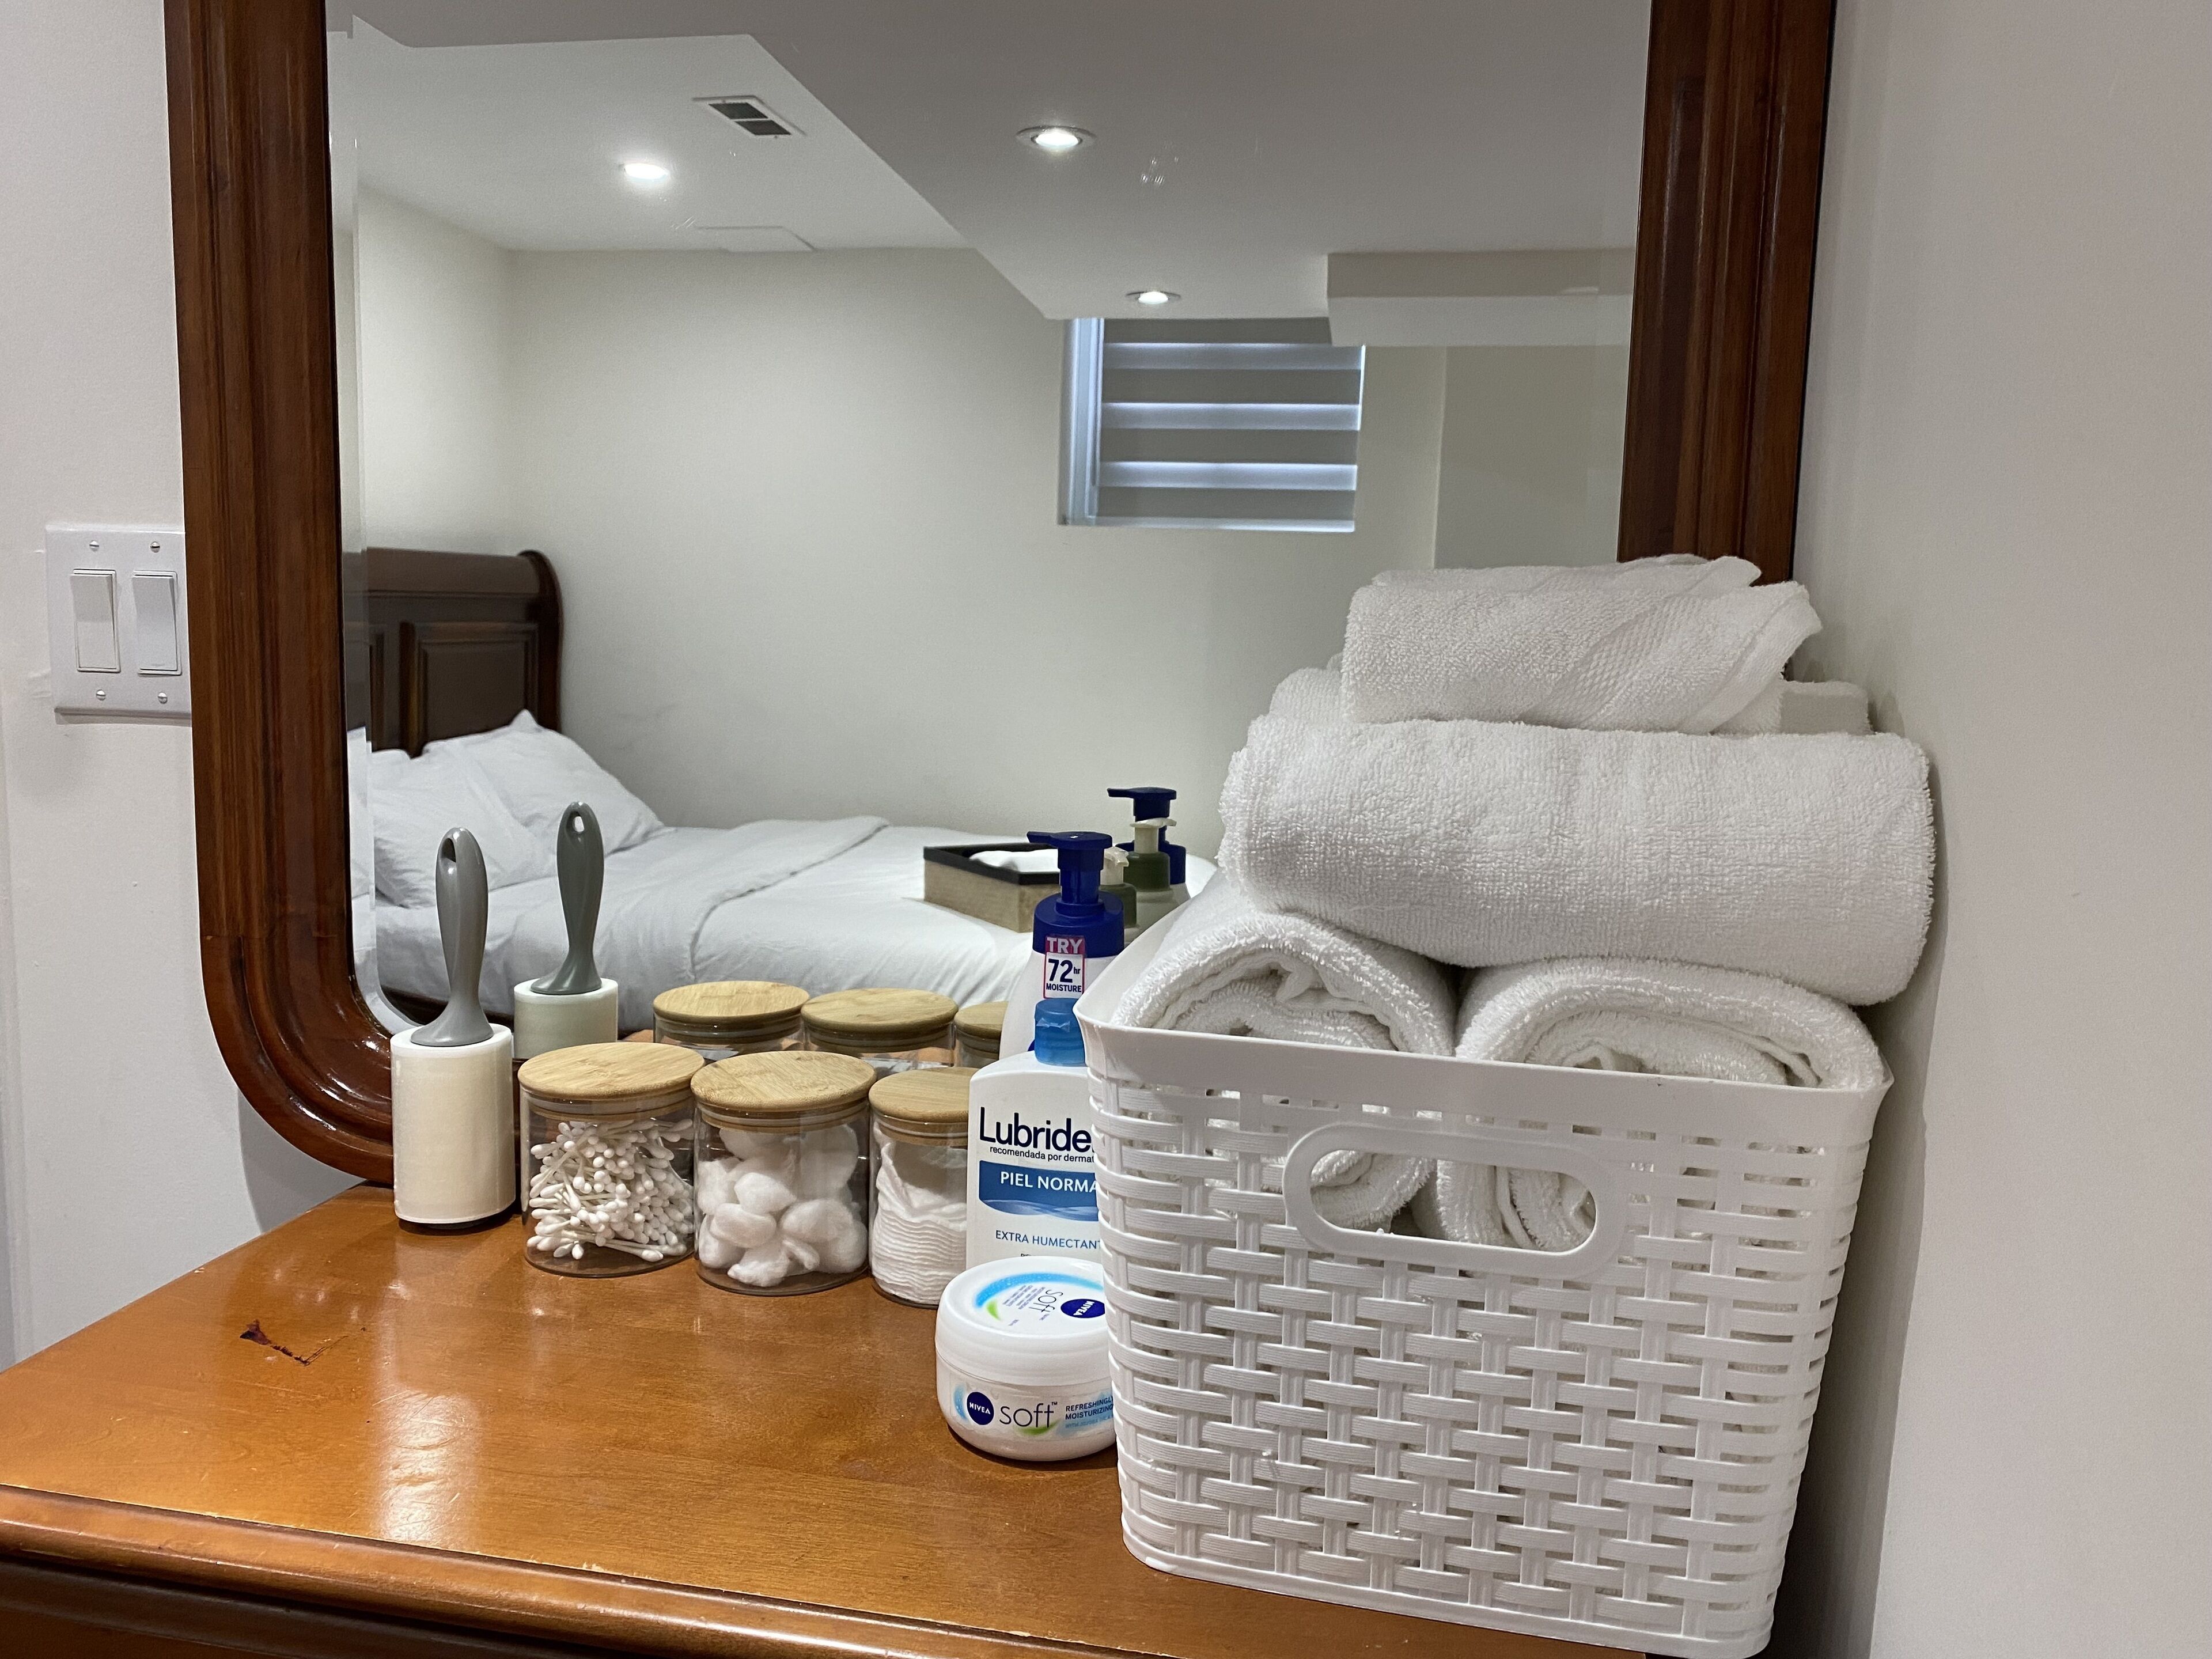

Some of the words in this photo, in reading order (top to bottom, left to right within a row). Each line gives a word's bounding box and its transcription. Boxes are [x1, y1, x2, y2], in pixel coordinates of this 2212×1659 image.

[1047, 937, 1082, 954] TRY
[1046, 983, 1082, 993] MOISTURE
[980, 1107, 1094, 1153] Lubride
[990, 1146, 1046, 1160] recomendada
[1048, 1153, 1062, 1164] por
[1001, 1171, 1033, 1188] PIEL
[995, 1230, 1029, 1244] EXTRA
[1073, 1300, 1094, 1316] NIVEA
[969, 1402, 991, 1415] NIVEA
